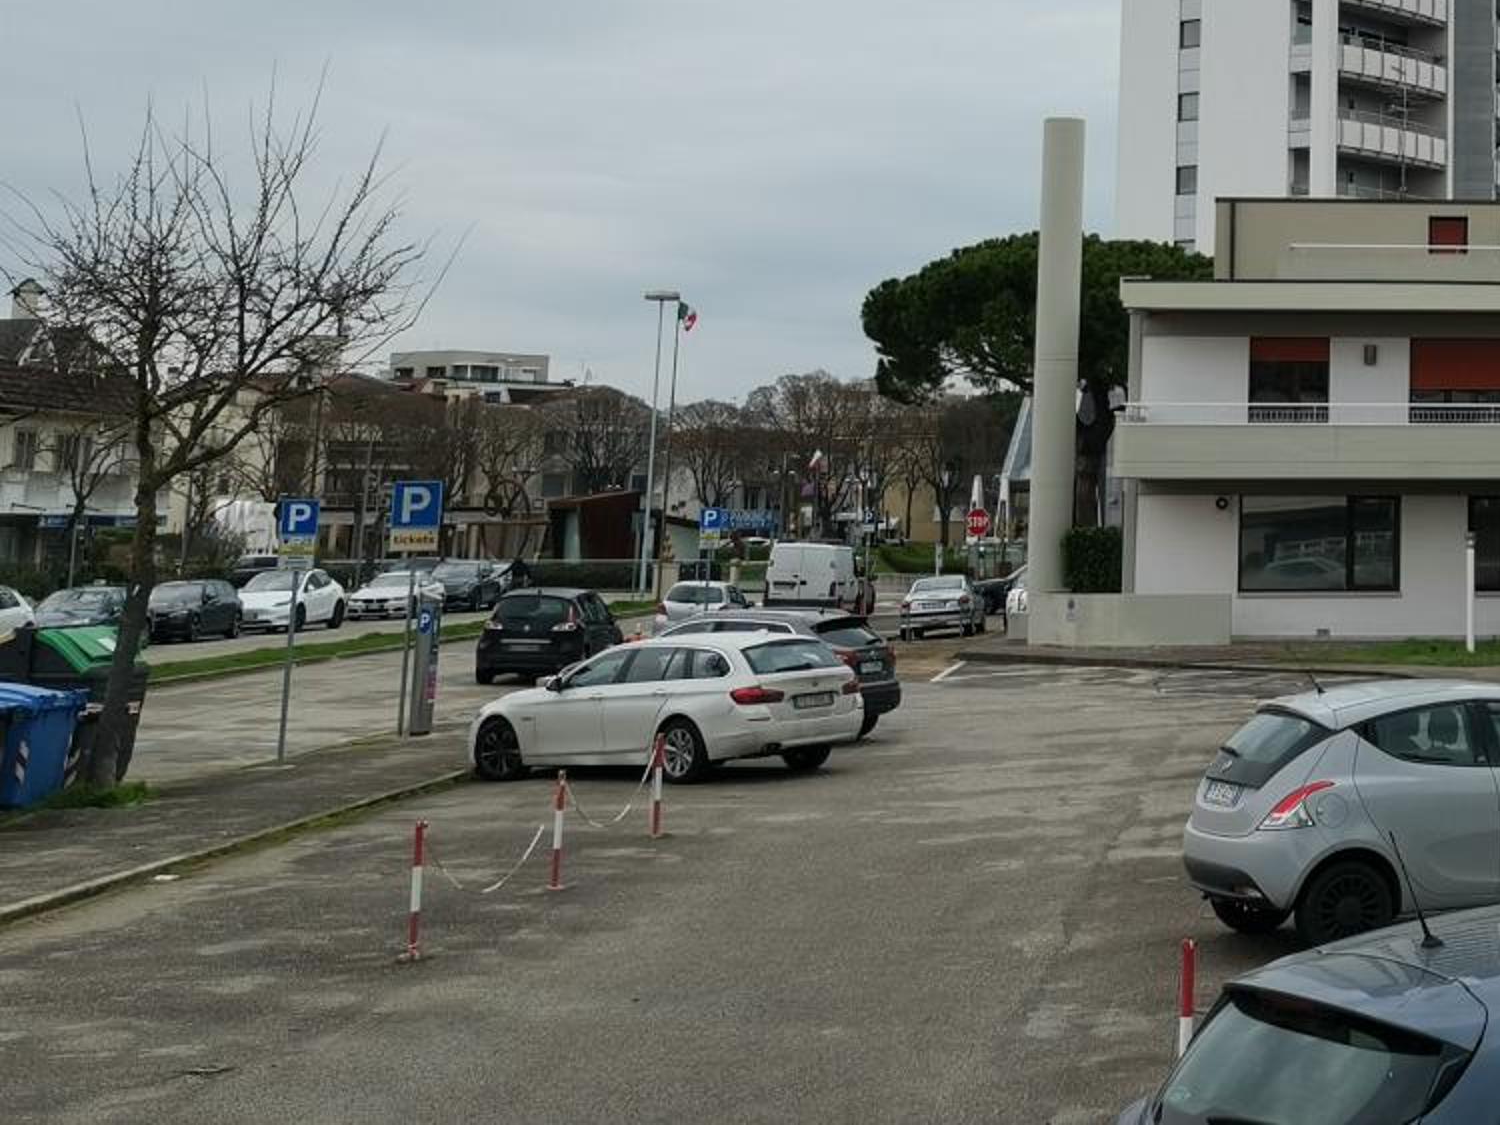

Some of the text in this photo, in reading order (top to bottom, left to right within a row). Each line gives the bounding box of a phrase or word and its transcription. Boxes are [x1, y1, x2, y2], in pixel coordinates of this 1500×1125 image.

[402, 486, 431, 523] P
[288, 503, 311, 531] P
[704, 510, 717, 526] P
[967, 516, 989, 528] STOP
[393, 532, 435, 546] tickets
